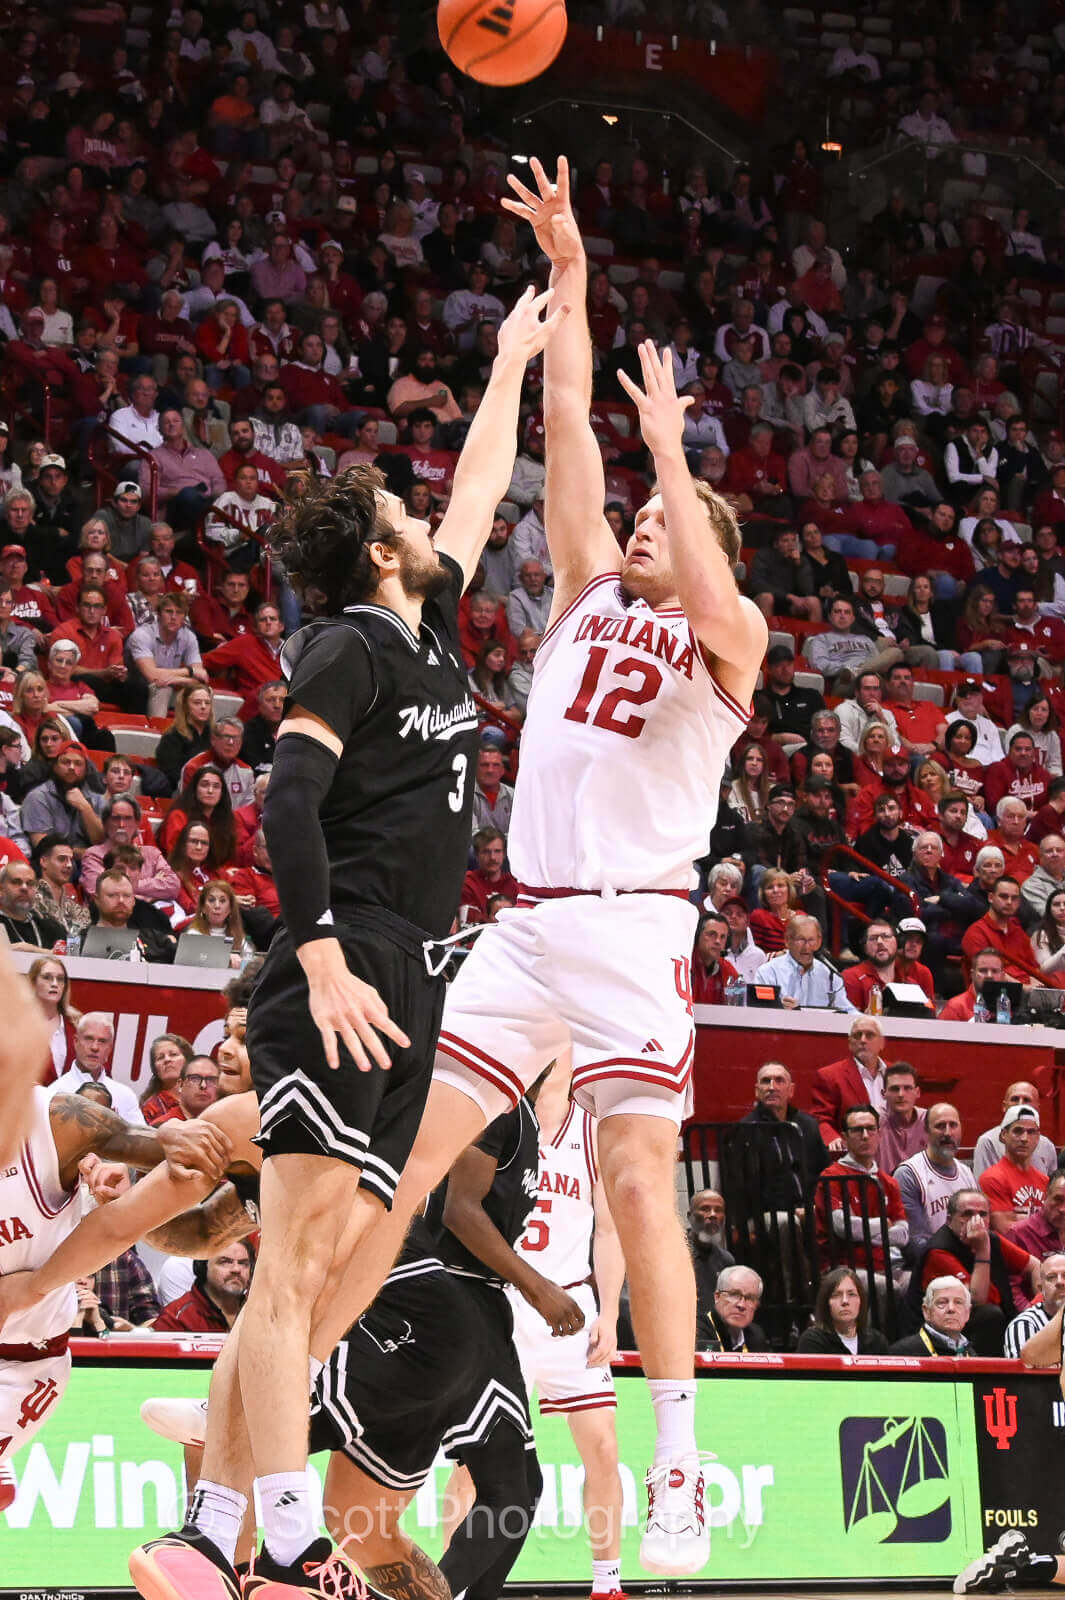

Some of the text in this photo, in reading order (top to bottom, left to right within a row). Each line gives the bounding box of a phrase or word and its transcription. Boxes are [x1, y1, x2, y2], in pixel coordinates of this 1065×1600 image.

[644, 43, 664, 71] E
[83, 138, 117, 158] INDIANA
[573, 613, 694, 682] INDIANA
[564, 646, 663, 739] 12
[398, 690, 477, 741] Milwauk
[447, 753, 467, 812] 3
[1011, 1185, 1045, 1207] INDIAN
[0, 1216, 34, 1247] NA
[519, 1199, 553, 1252] 5
[984, 1509, 1038, 1527] FOULS
